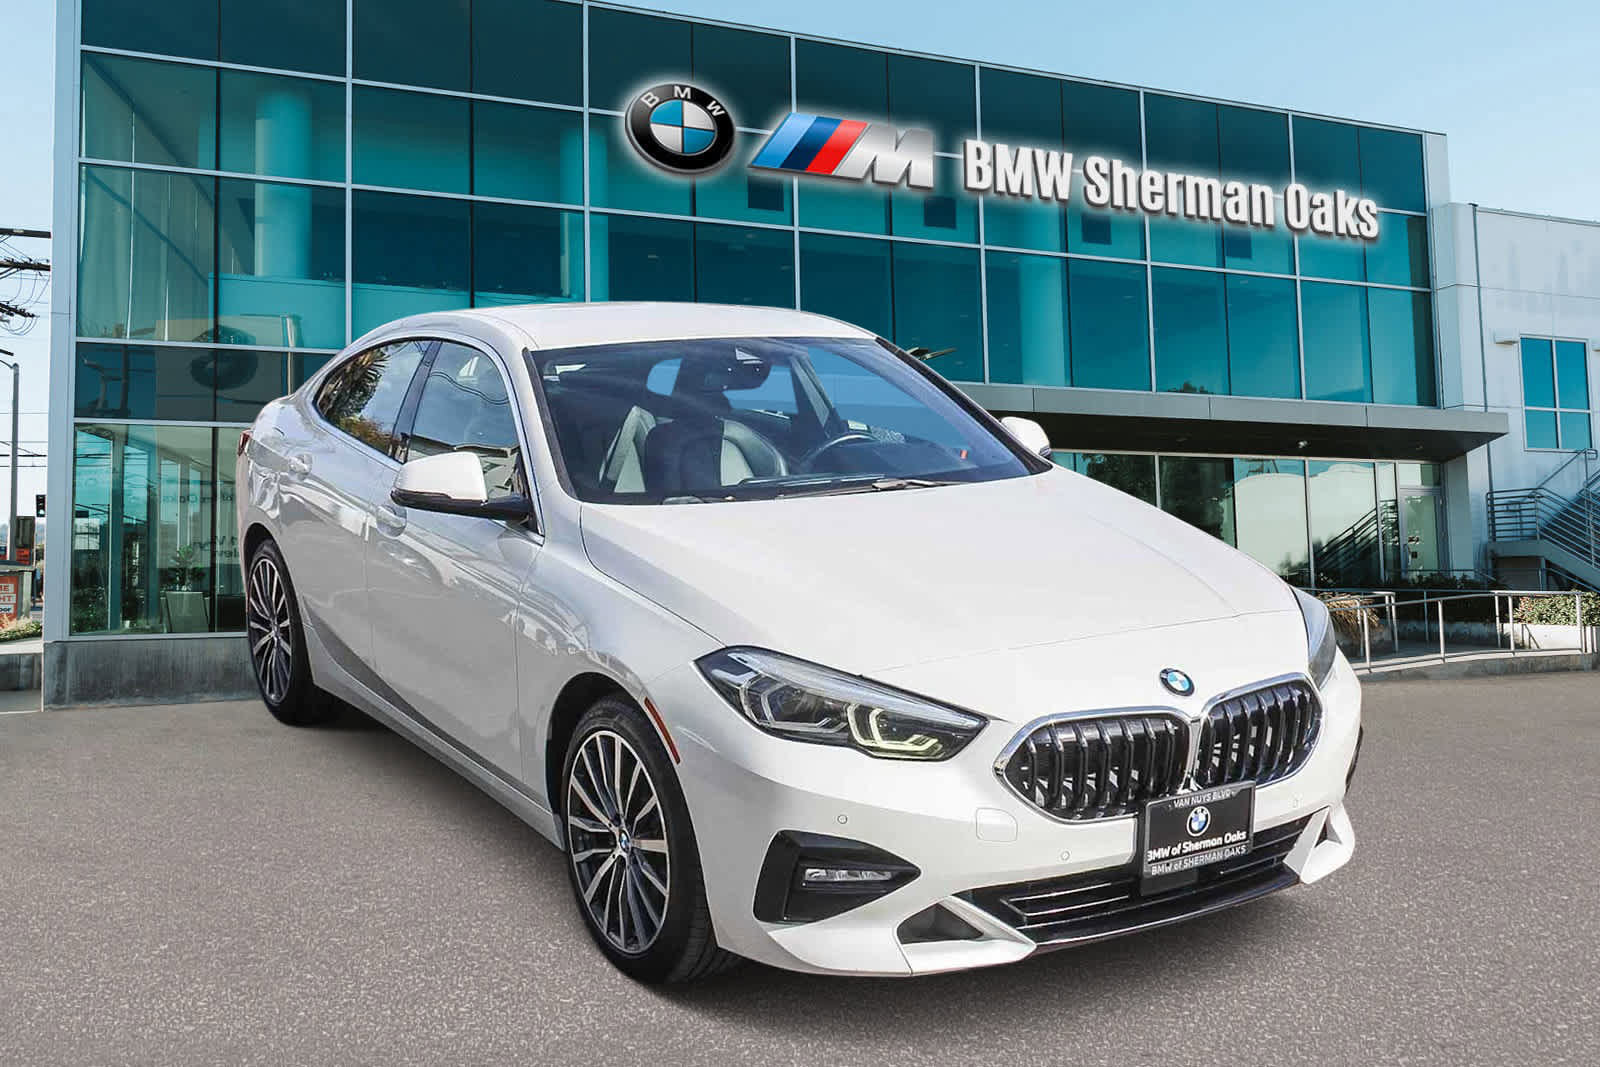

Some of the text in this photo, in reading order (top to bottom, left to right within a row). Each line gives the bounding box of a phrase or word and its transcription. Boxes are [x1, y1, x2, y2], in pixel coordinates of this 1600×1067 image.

[641, 85, 725, 117] BMW
[963, 139, 1380, 242] BMW Sherman Oaks
[1173, 797, 1190, 808] VAN
[1191, 792, 1212, 805] NUYS
[1171, 843, 1182, 856] of
[1182, 837, 1223, 853] Sherman
[1224, 830, 1247, 843] Oaks
[1152, 862, 1173, 875] BMW
[1183, 850, 1224, 869] SHERMAN
[1225, 845, 1246, 859] OAKS
